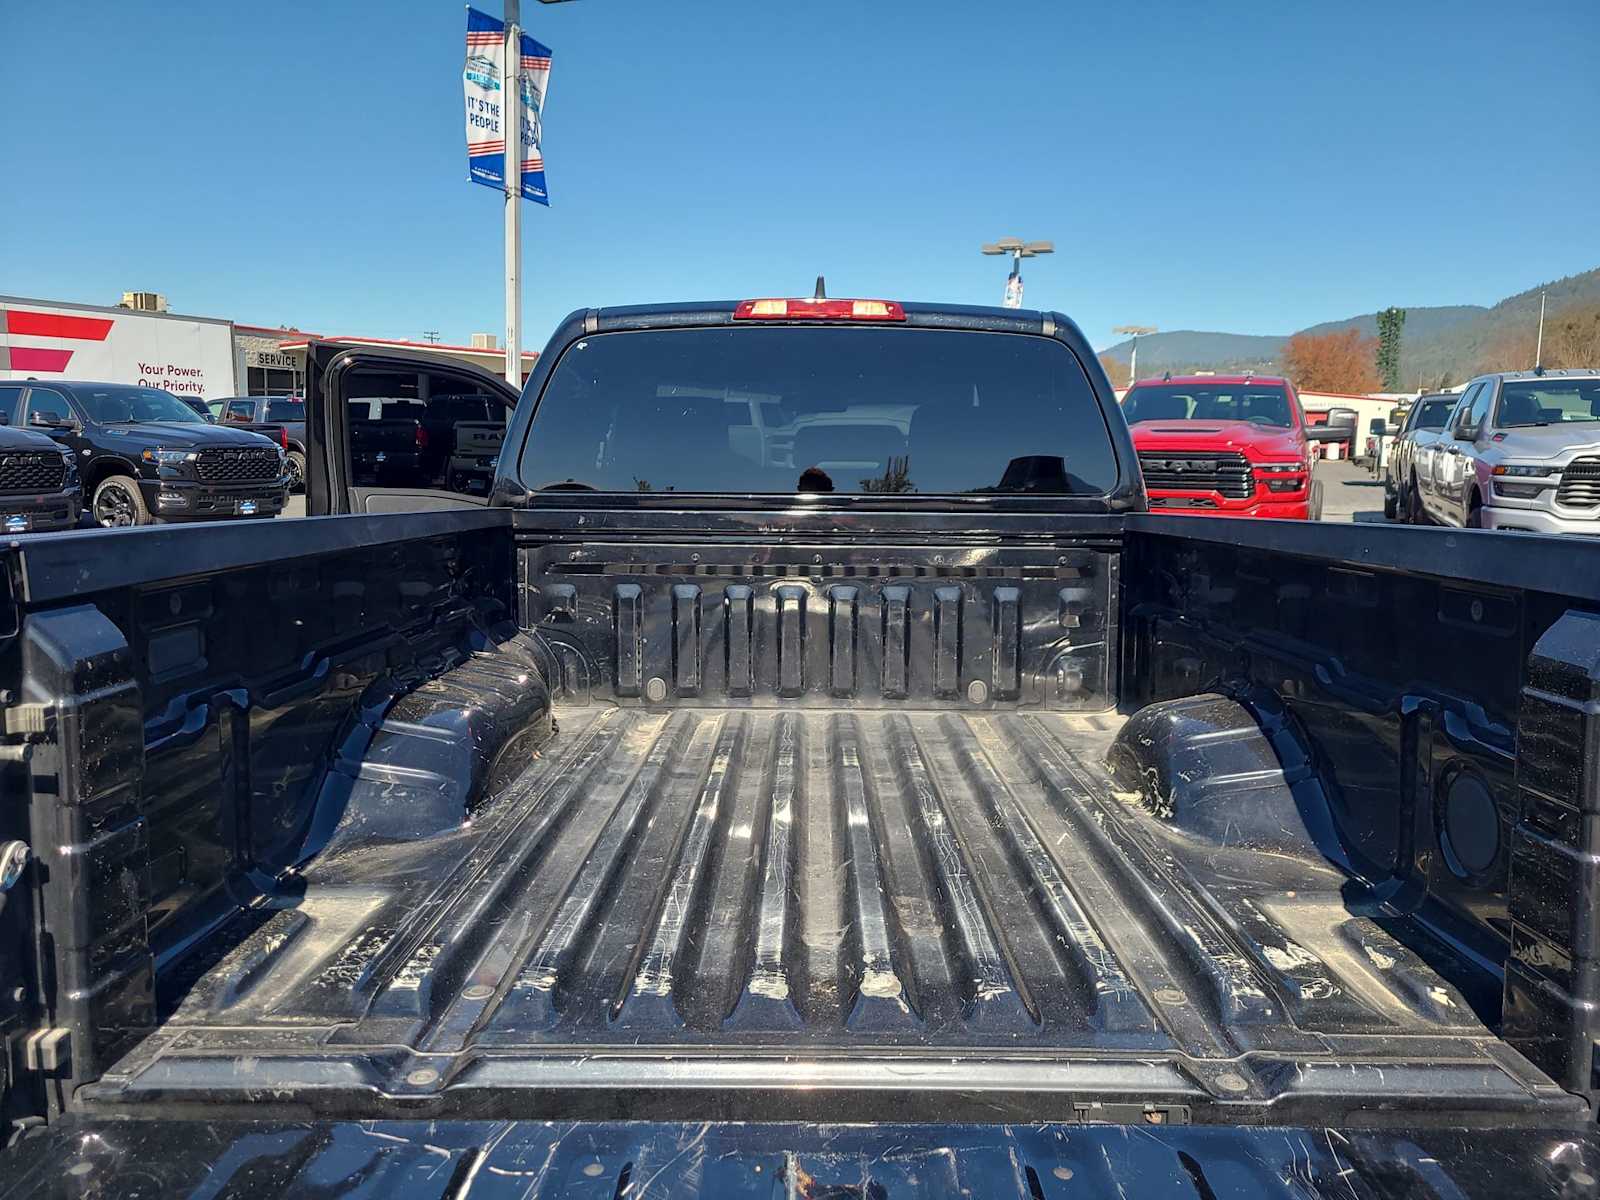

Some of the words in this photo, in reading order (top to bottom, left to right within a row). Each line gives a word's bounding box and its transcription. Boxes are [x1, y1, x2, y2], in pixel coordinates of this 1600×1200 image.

[467, 95, 484, 112] IT'S
[484, 101, 500, 118] THE
[469, 113, 499, 133] PEOPLE
[258, 353, 297, 367] SERVICE
[137, 362, 164, 375] Your
[167, 365, 203, 377] Power.
[163, 380, 205, 394] Priority.
[1141, 459, 1217, 471] RAM
